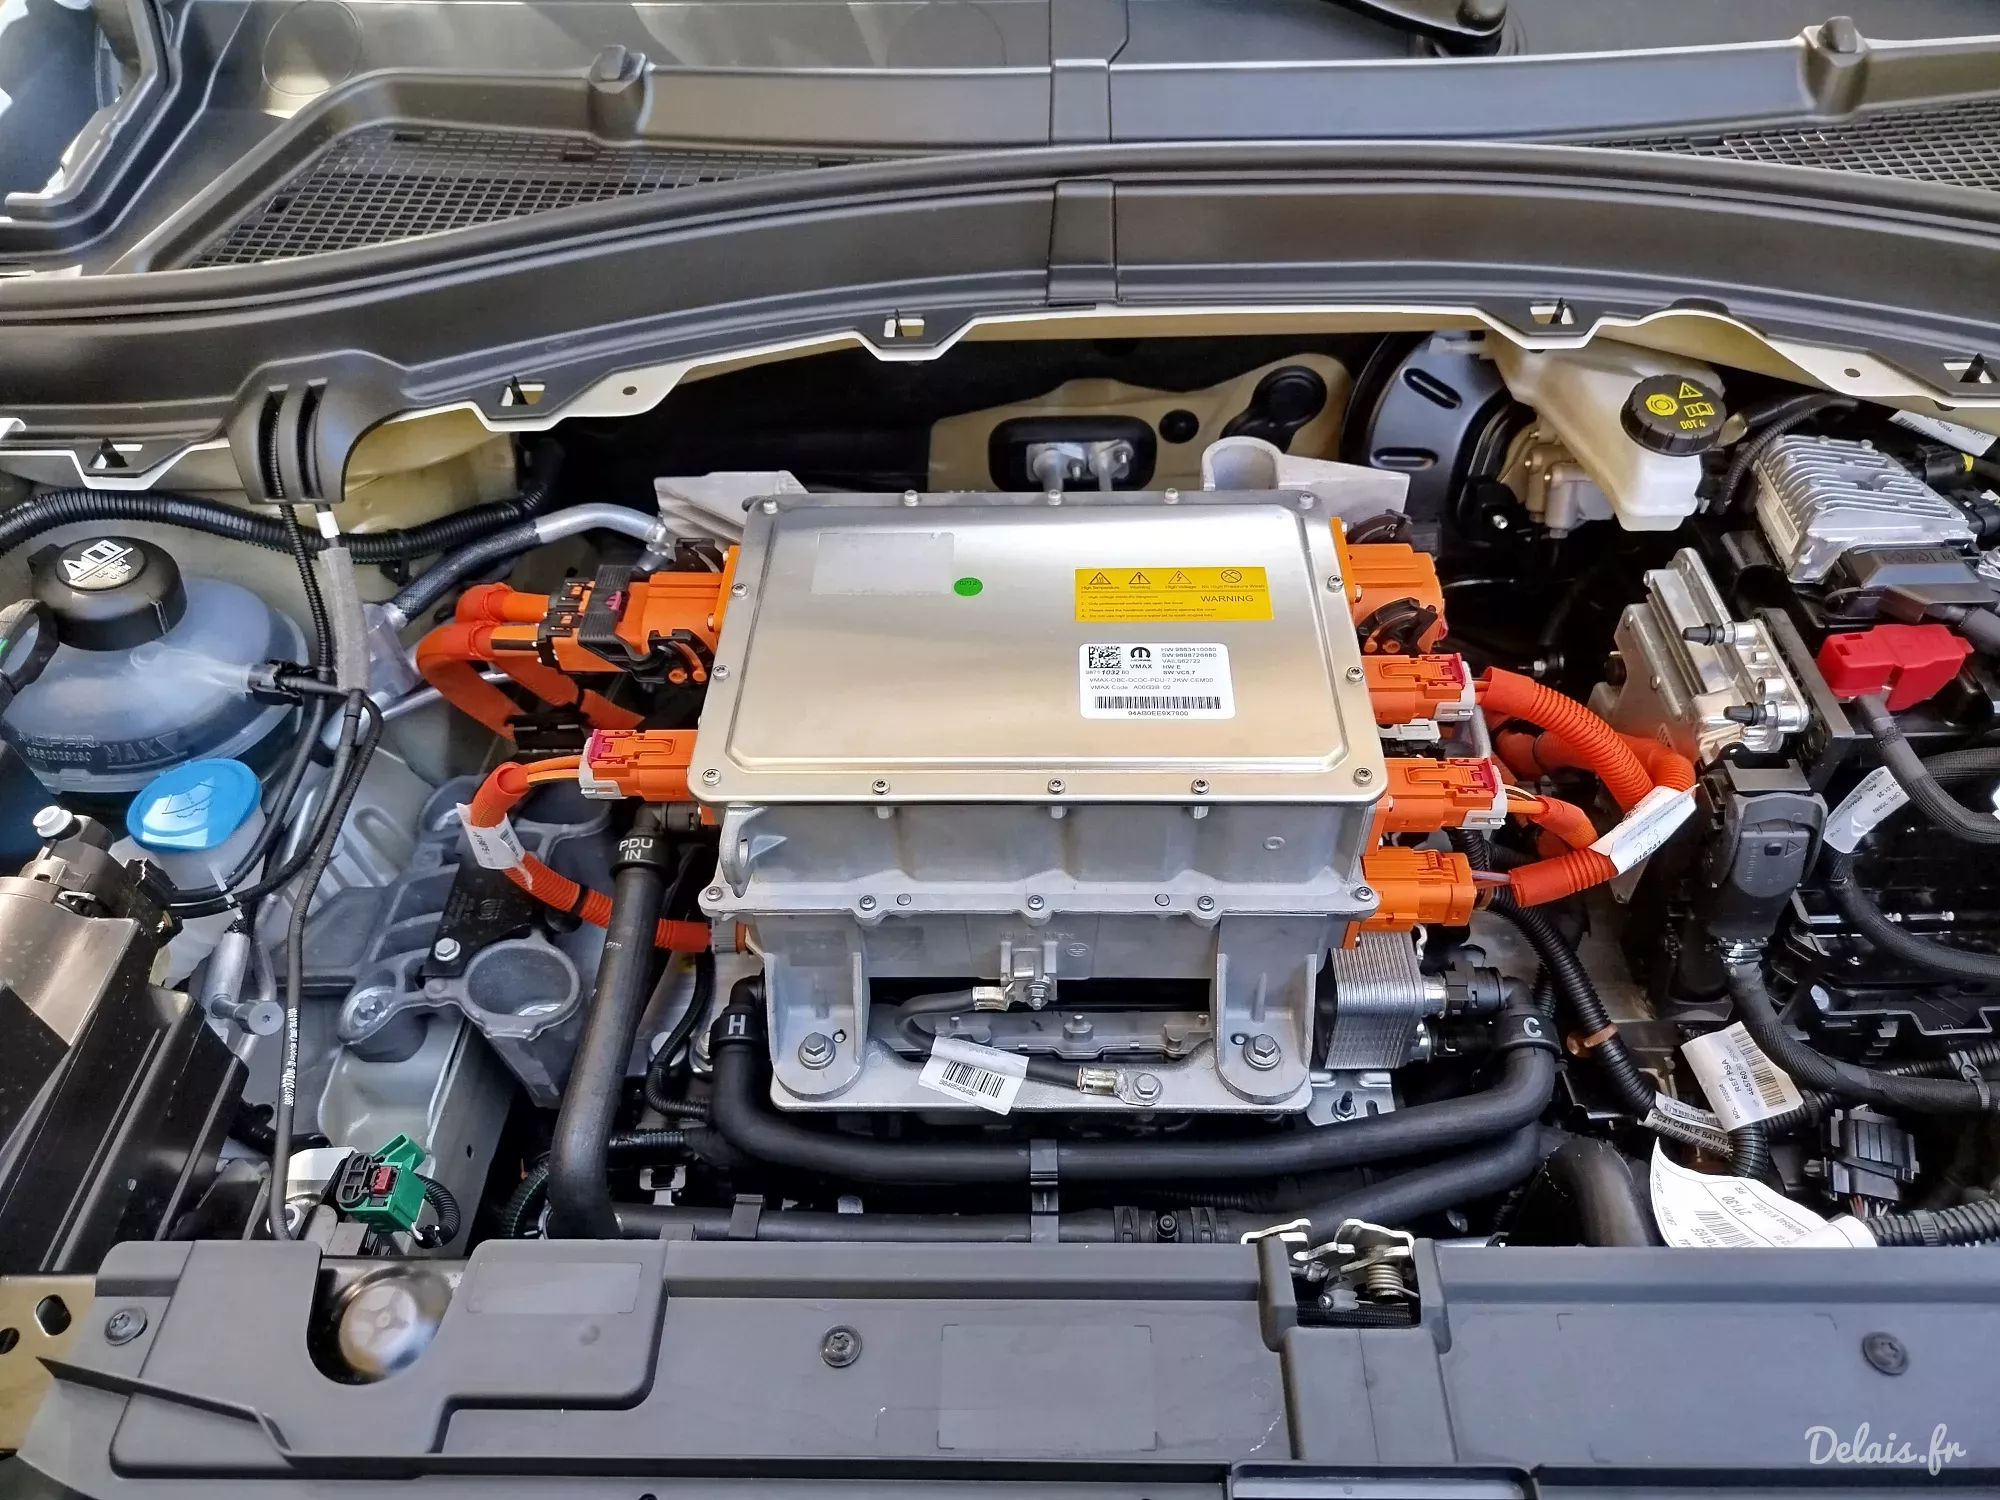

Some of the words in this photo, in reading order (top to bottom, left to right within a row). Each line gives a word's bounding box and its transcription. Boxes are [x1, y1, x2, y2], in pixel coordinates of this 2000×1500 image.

[1679, 420, 1697, 430] DOT
[1699, 419, 1706, 428] 4
[1200, 594, 1254, 603] WARNING
[104, 735, 159, 763] MAX
[618, 838, 654, 852] PDU
[624, 849, 642, 861] IN
[728, 1014, 747, 1034] H
[1523, 1016, 1542, 1038] C
[1721, 1058, 1734, 1076] PSA
[1728, 1076, 1742, 1093] REF
[1650, 1112, 1672, 1126] CC21
[1672, 1119, 1701, 1136] CABLE
